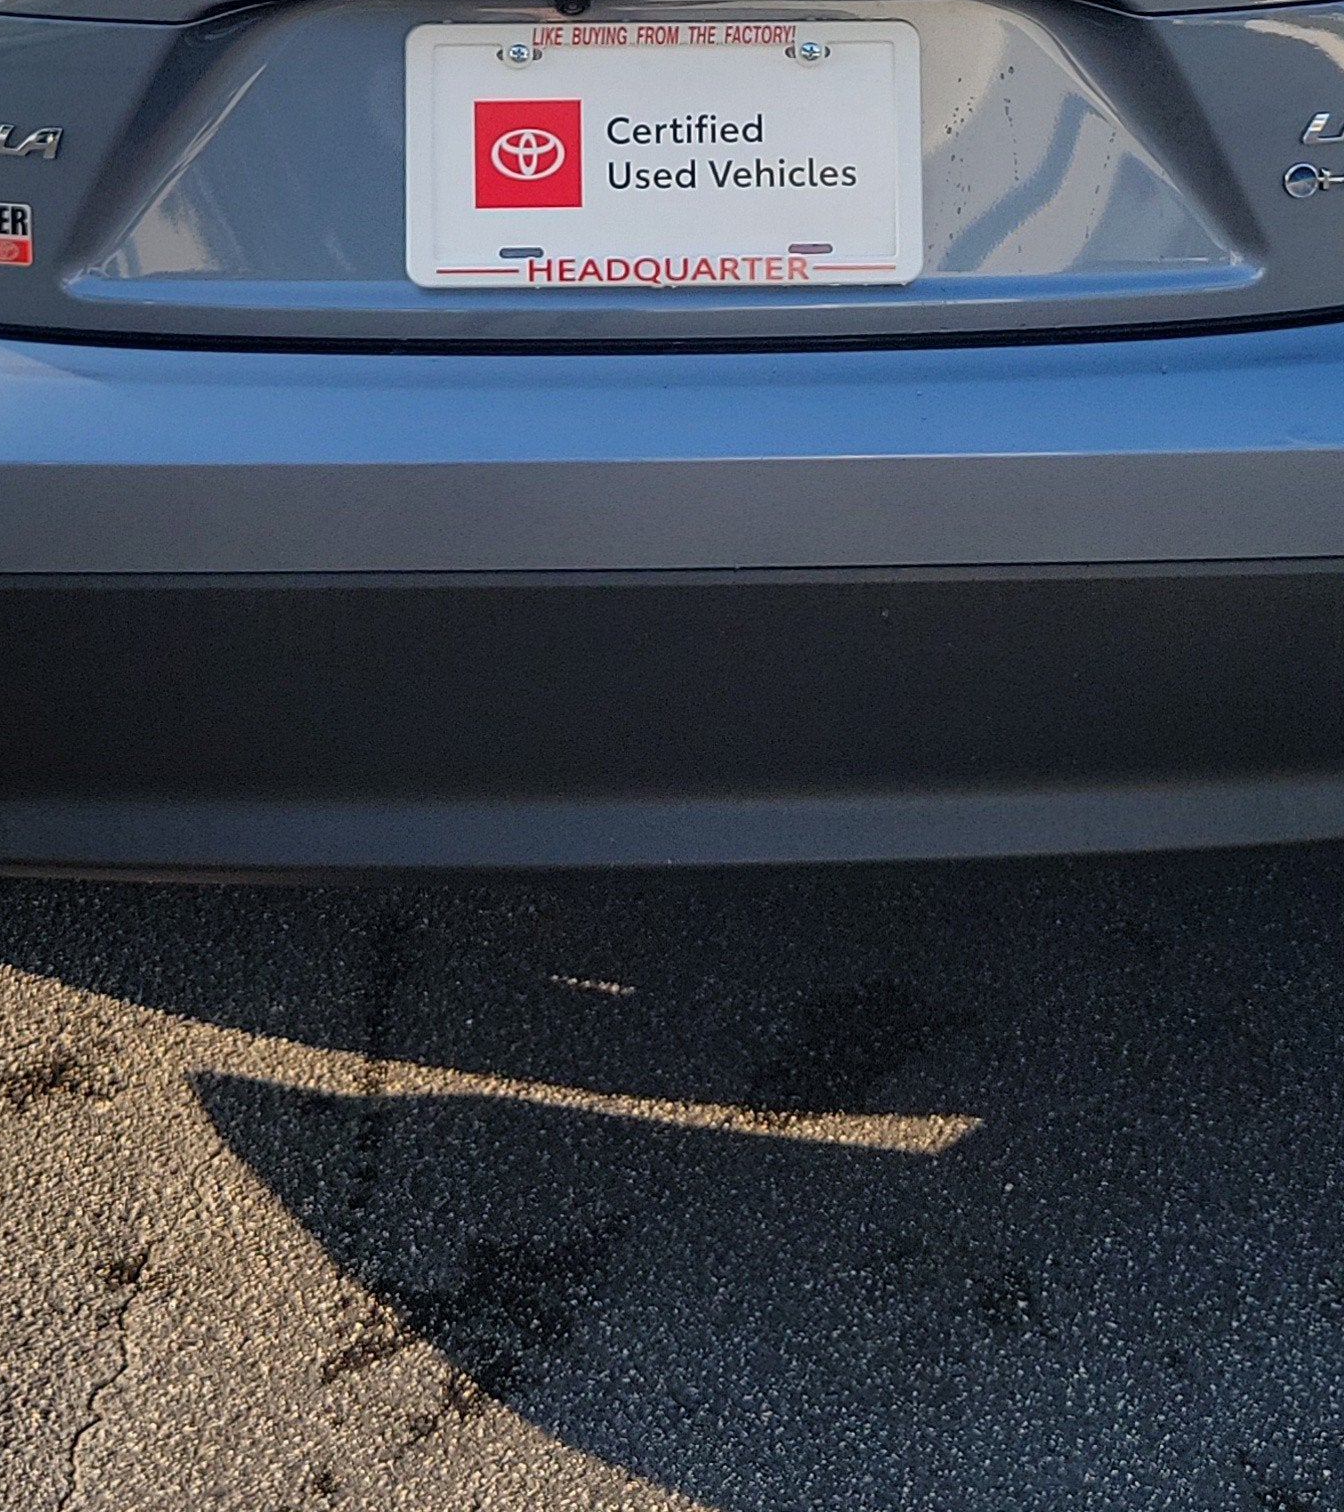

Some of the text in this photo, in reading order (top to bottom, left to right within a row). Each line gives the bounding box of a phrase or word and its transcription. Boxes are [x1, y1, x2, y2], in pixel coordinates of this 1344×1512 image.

[532, 25, 796, 47] LIKE BUYING FROM THE FACTORY!
[606, 114, 764, 144] Certified
[607, 158, 857, 190] Used Vehicles
[527, 256, 810, 283] HEADQUARTER
